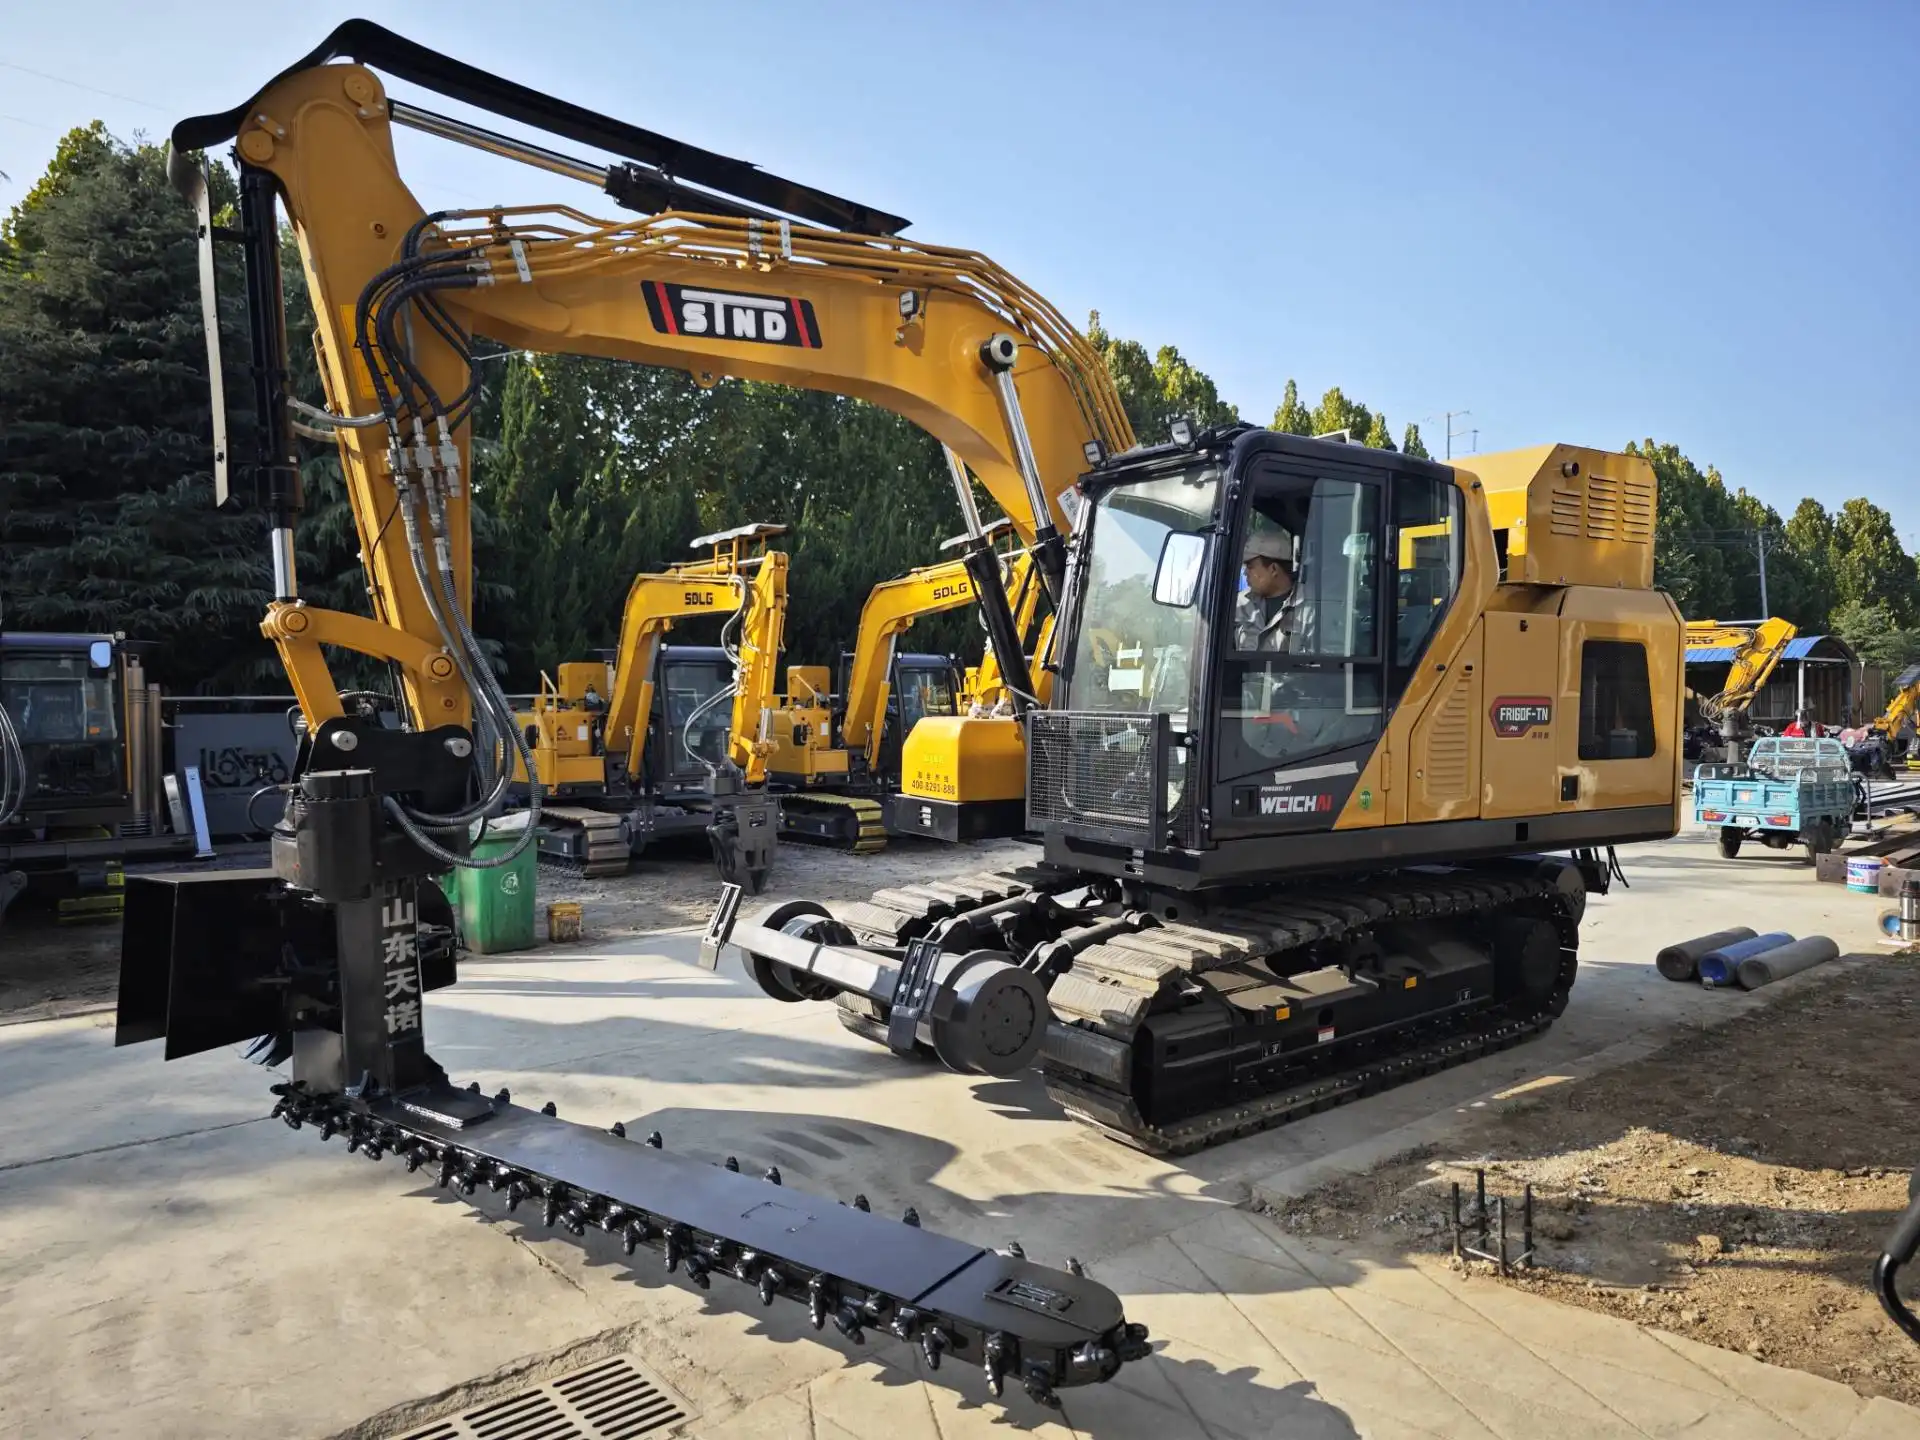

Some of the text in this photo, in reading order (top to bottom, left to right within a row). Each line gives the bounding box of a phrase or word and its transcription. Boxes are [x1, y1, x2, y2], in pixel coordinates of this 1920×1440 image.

[680, 289, 787, 341] STND
[684, 592, 714, 605] SDLG
[934, 582, 968, 600] SDLG
[1261, 795, 1332, 813] WEICHAI
[381, 898, 419, 1034] 山东天诺
